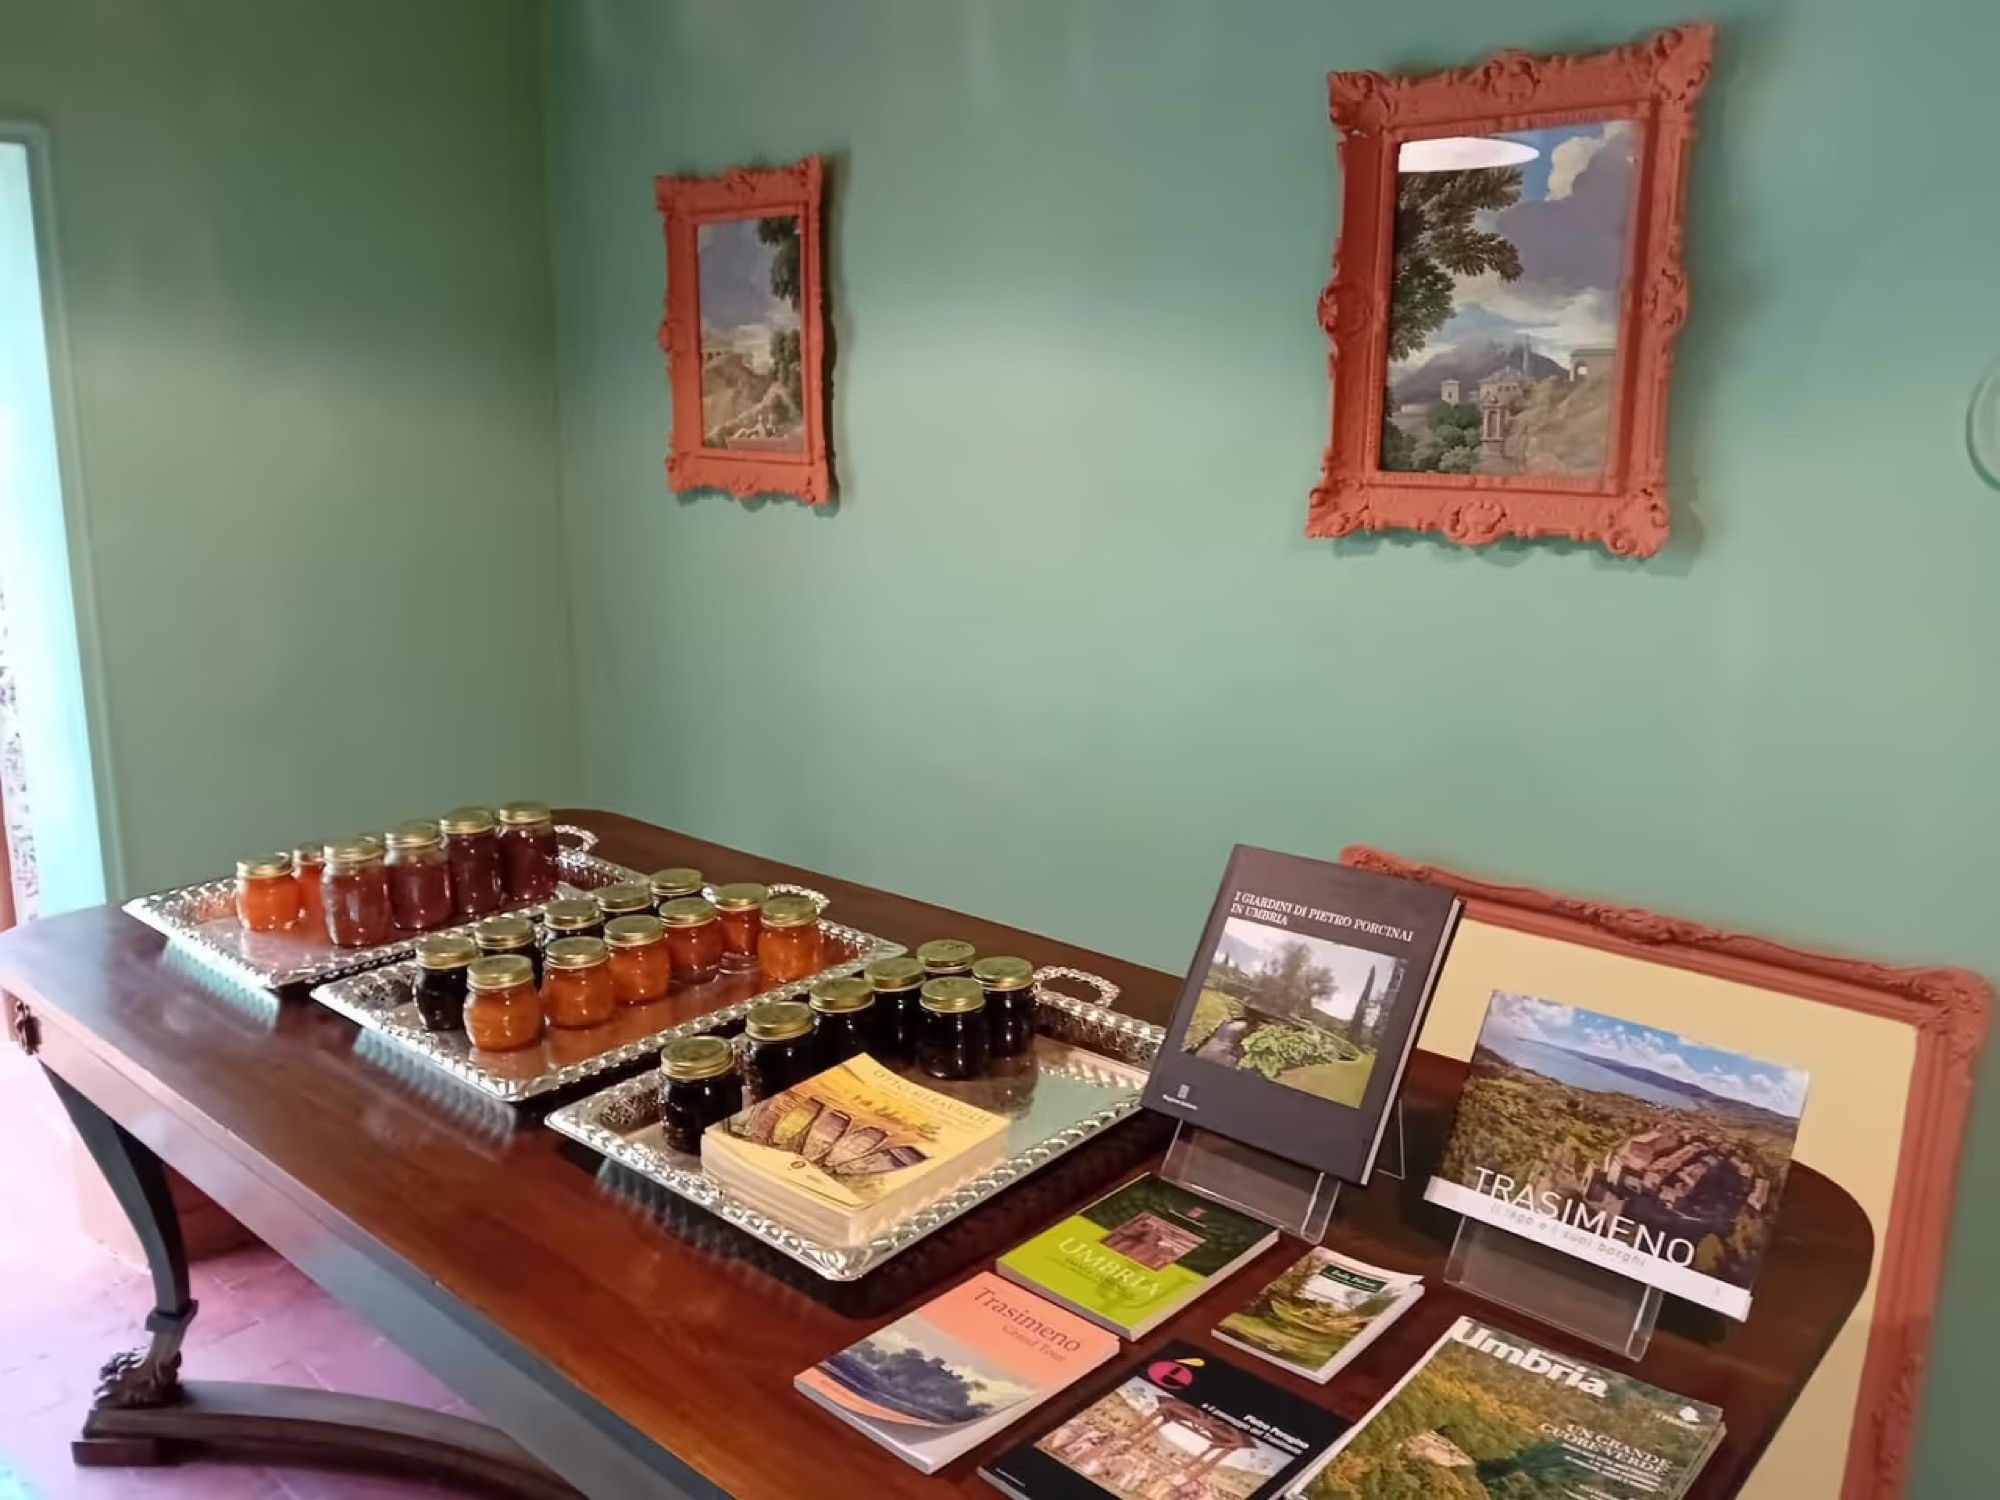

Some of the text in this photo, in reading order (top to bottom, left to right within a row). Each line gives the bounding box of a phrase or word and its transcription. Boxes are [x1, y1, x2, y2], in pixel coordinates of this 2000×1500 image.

[1230, 902, 1289, 926] IN UMBRIA
[1240, 893, 1293, 915] GIARDINI
[1293, 905, 1307, 919] DI
[1308, 908, 1353, 928] PIETRO
[1354, 919, 1415, 943] PORCINAI
[1474, 1166, 1696, 1268] TRASIMENO
[1059, 1237, 1160, 1298] UMBRIA
[974, 1286, 1081, 1352] Trasimeno
[1450, 1315, 1609, 1398] Umbria
[1595, 1434, 1673, 1470] GRANDE
[1605, 1447, 1672, 1477] VERDE
